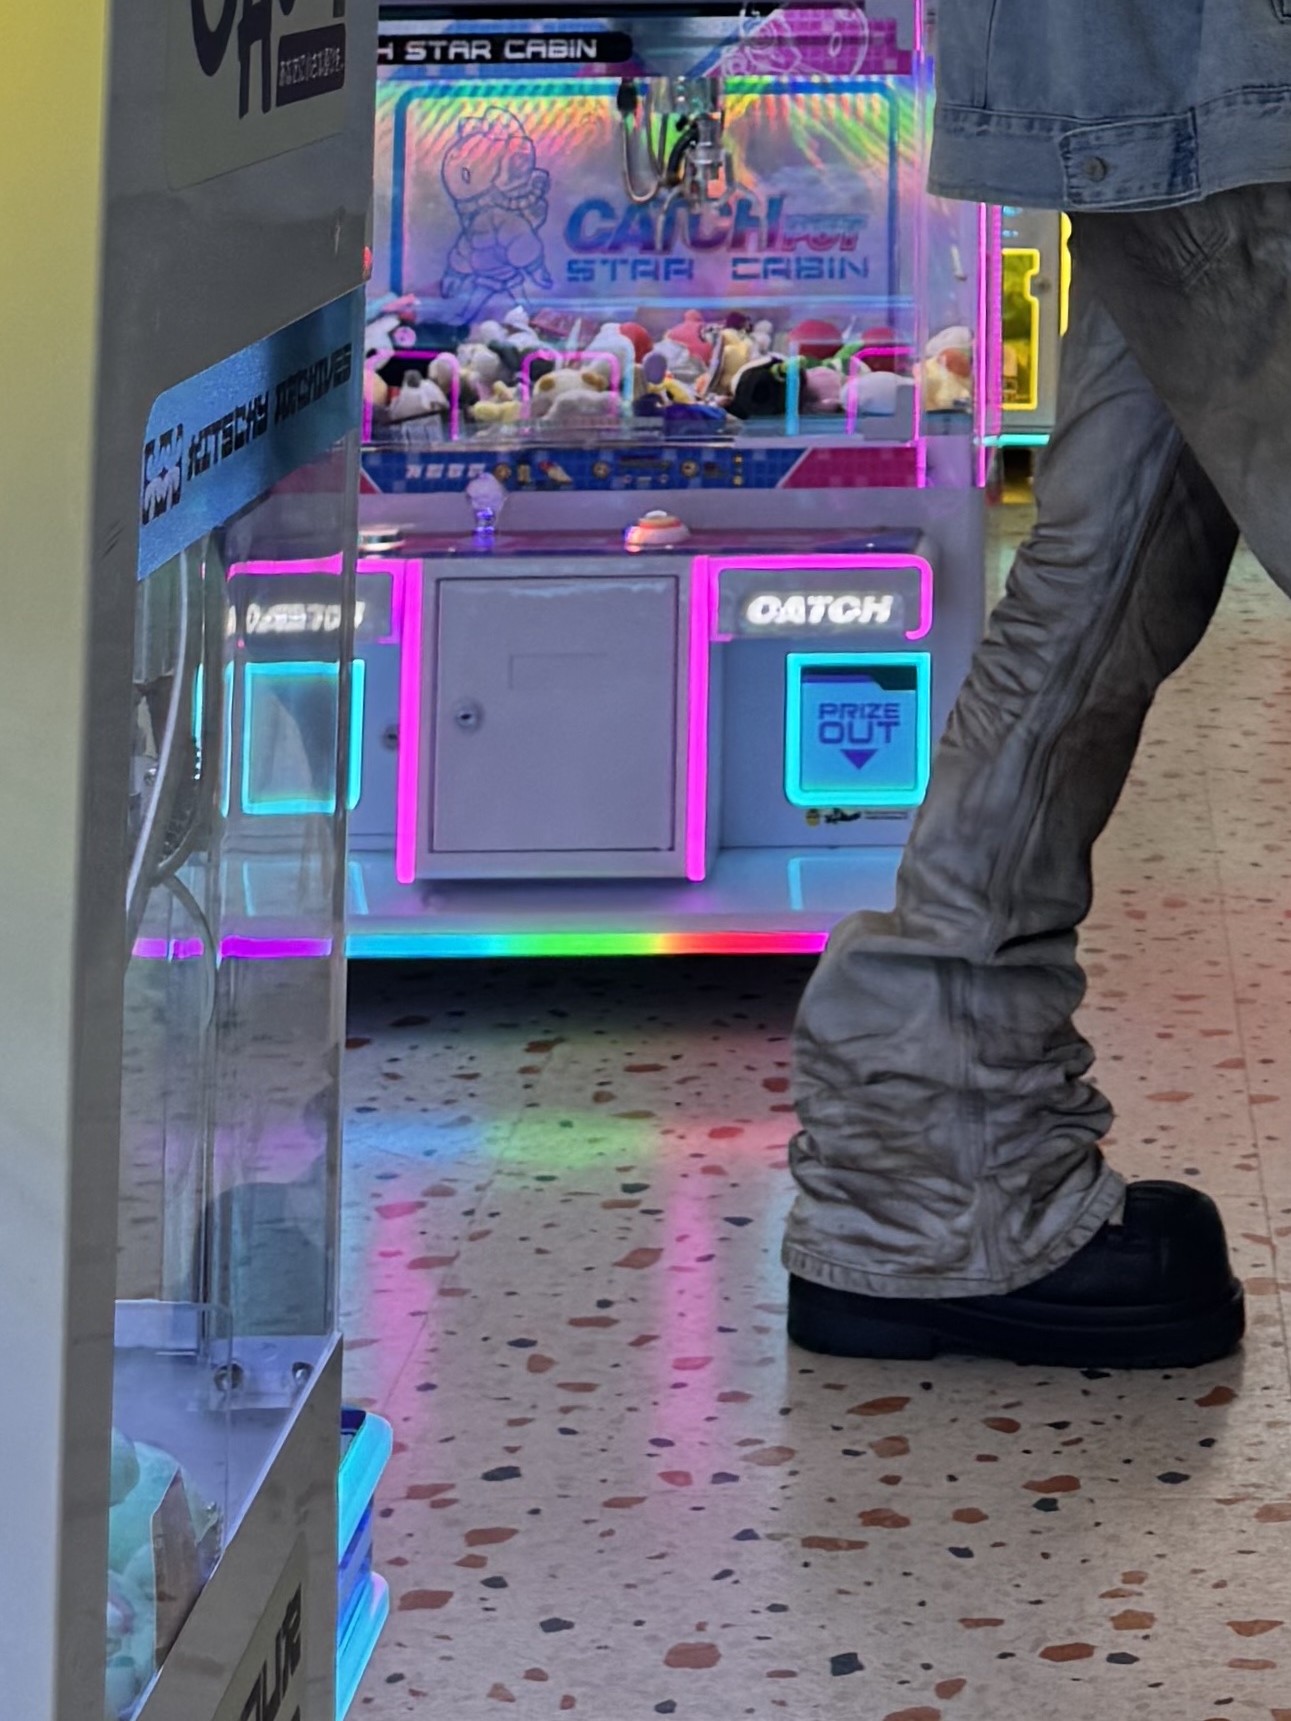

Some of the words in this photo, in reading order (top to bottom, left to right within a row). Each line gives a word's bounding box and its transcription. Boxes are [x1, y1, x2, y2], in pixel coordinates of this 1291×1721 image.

[405, 41, 492, 61] STAR
[503, 39, 598, 60] CABIN
[567, 199, 786, 254] CATCH
[567, 257, 695, 281] STAR
[732, 257, 869, 280] CABIN
[818, 703, 900, 720] PRIZE
[818, 721, 900, 745] OUT
